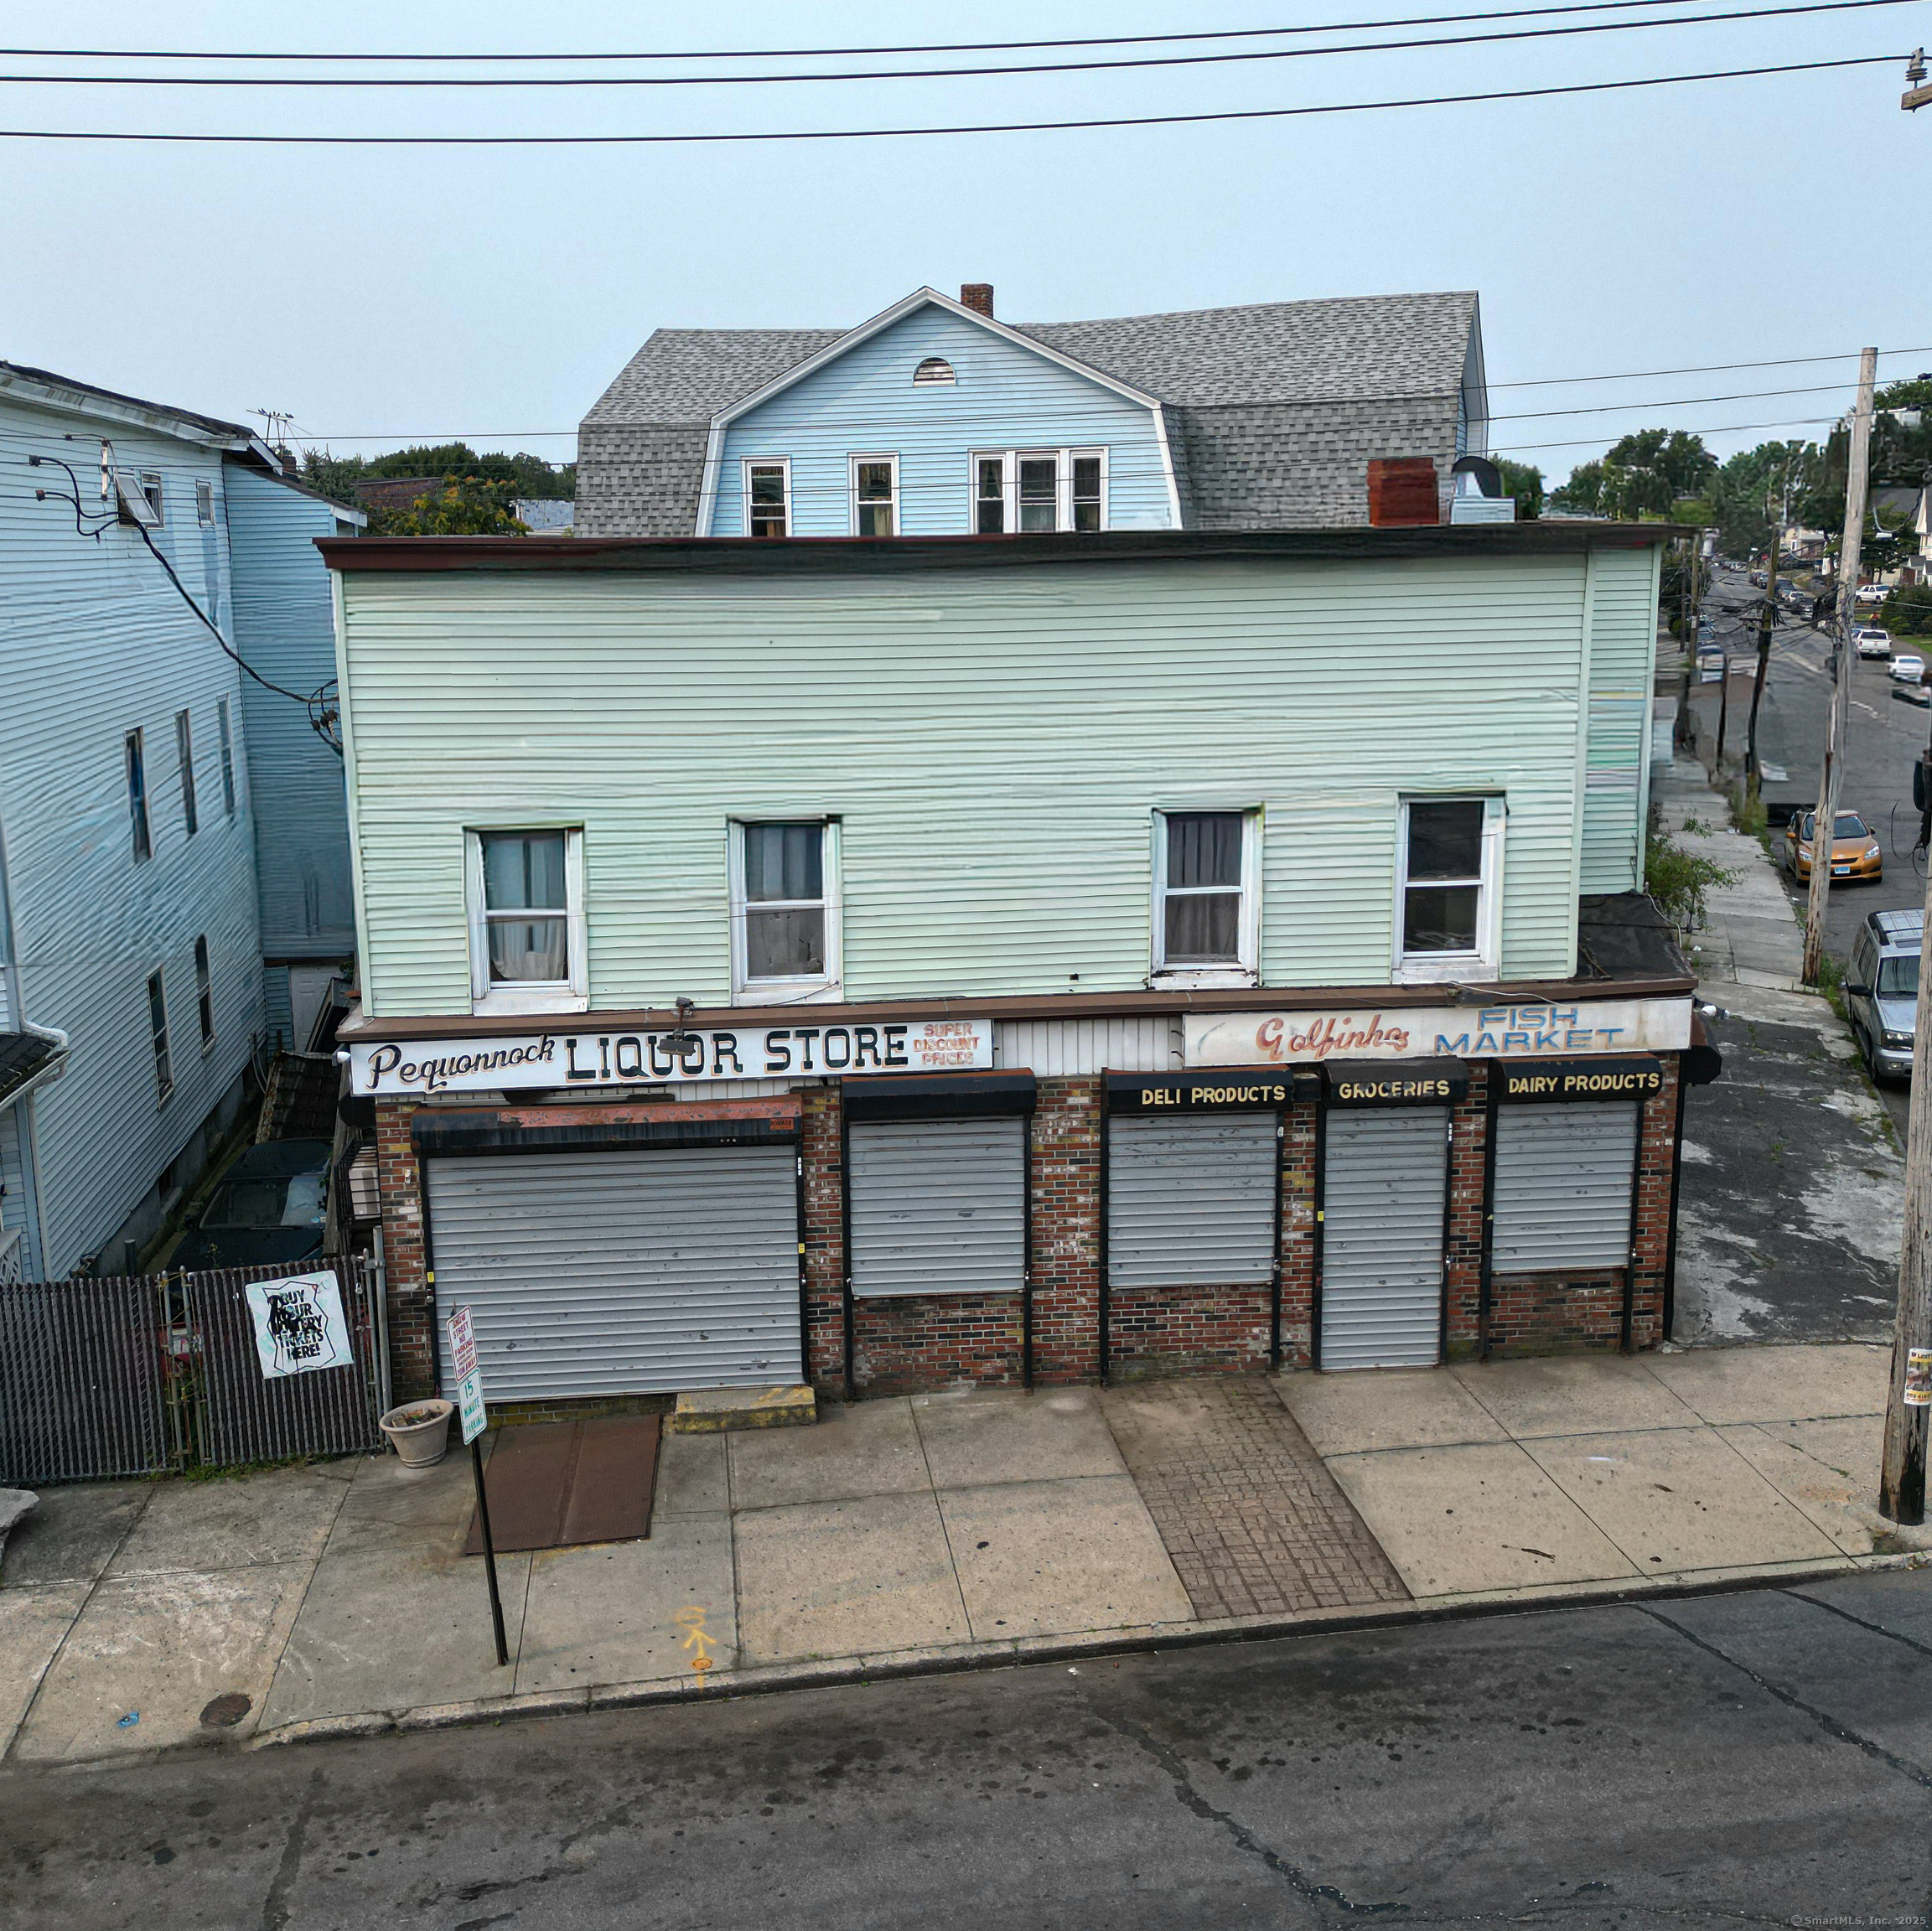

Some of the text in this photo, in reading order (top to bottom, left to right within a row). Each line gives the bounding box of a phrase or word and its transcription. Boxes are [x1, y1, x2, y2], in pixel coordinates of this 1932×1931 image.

[1477, 1007, 1578, 1031] FISH
[924, 1022, 973, 1038] SUPER
[913, 1037, 980, 1052] DISCOUNT
[1434, 1028, 1624, 1056] MARKET
[365, 1025, 909, 1094] Pequonnock LIQUOR STORE
[921, 1051, 975, 1066] PRICES
[1339, 1079, 1451, 1100] GROCERIES
[1509, 1073, 1660, 1094] DAIRY PRODUCTS
[1142, 1085, 1286, 1105] DELI PRODUCTS
[280, 1289, 305, 1305] BUY
[453, 1321, 469, 1339] STREET
[458, 1333, 466, 1343] NO
[287, 1343, 321, 1360] HERE!
[454, 1337, 473, 1357] PARKING
[464, 1380, 474, 1399] 15
[464, 1396, 480, 1419] MINUTE
[465, 1413, 484, 1437] PARKING
